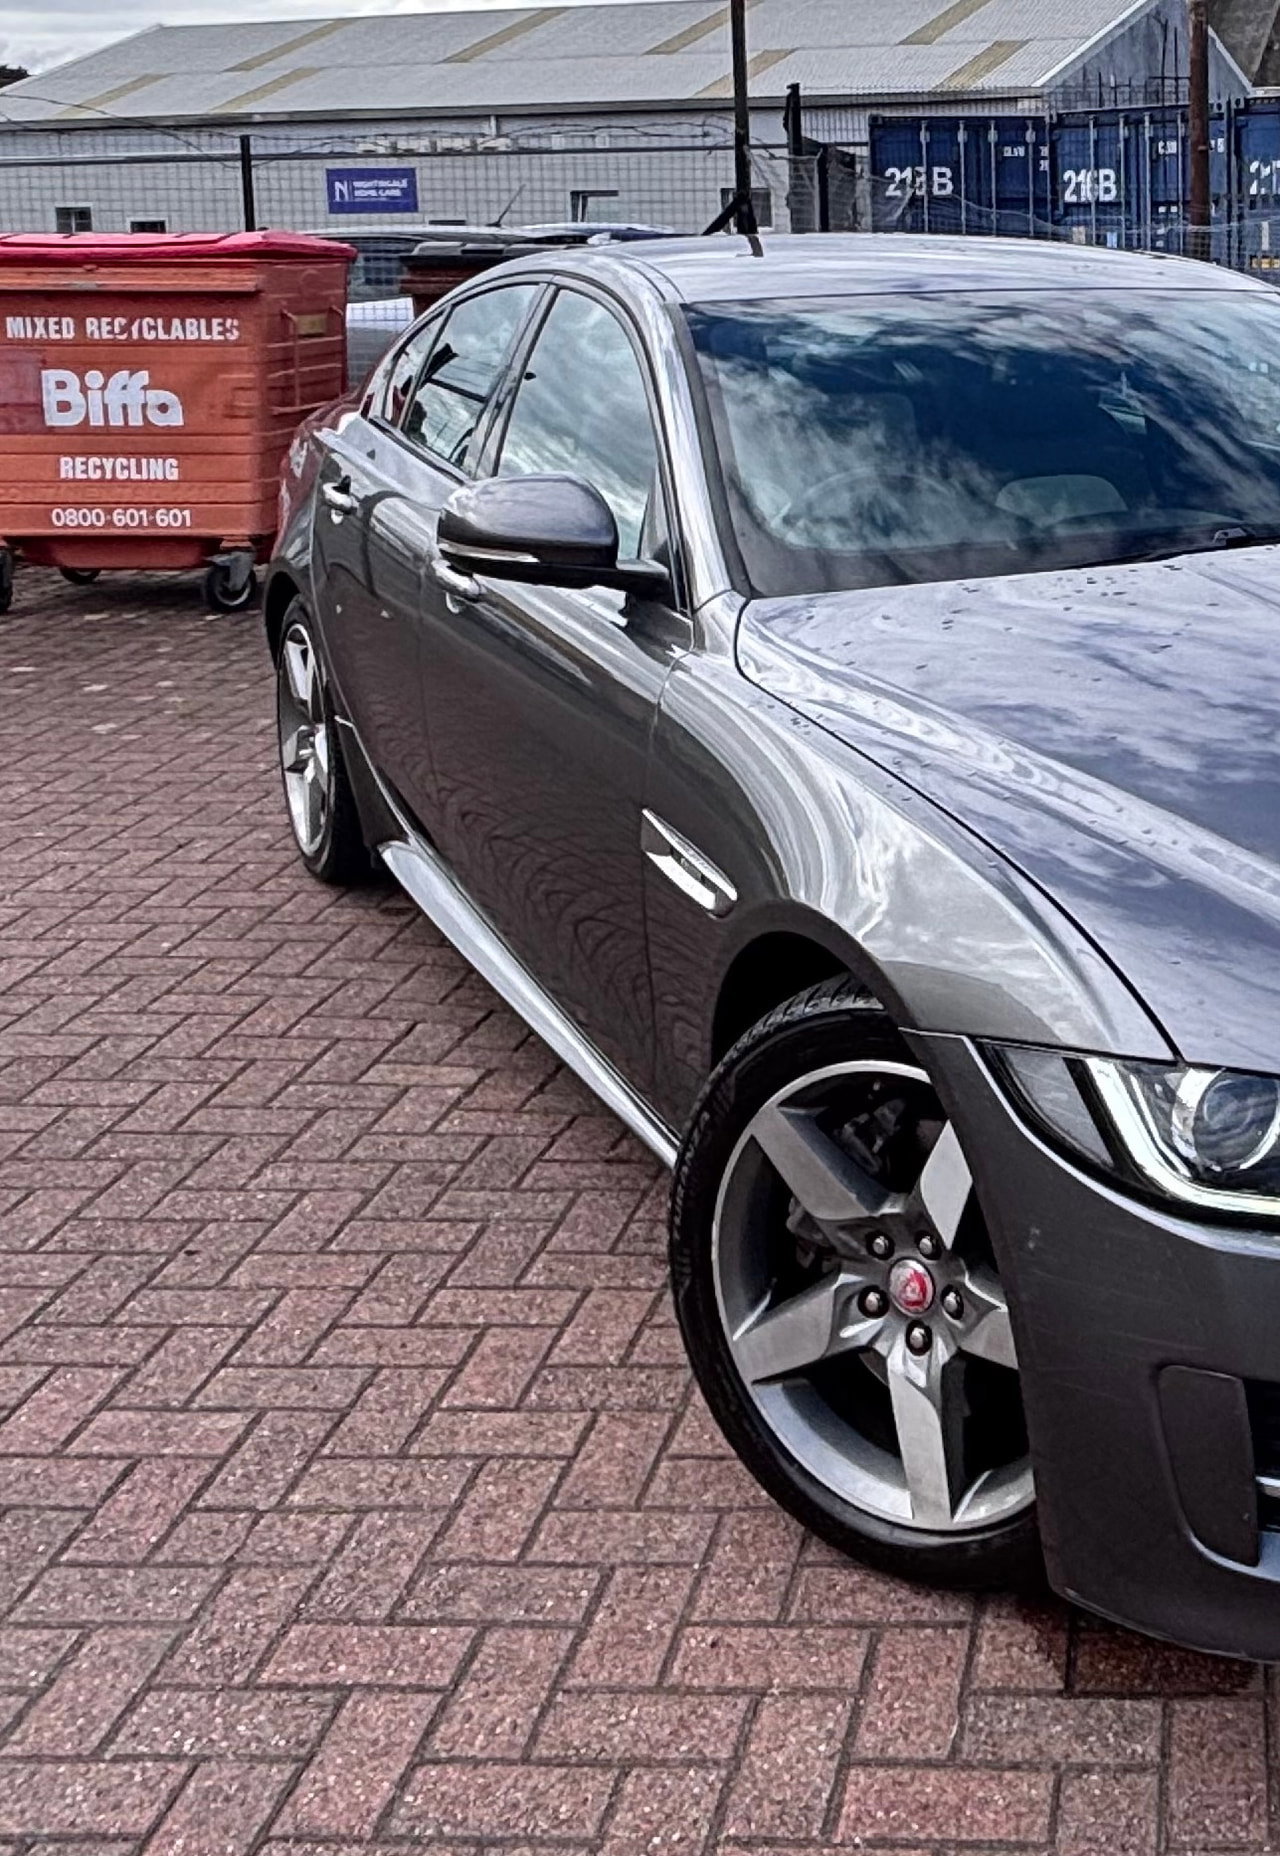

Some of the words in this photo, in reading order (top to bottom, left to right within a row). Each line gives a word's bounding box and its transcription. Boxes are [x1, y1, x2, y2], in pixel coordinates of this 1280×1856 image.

[6, 316, 75, 340] MIXED
[40, 368, 185, 427] Biffa
[59, 456, 179, 481] RECYCLING
